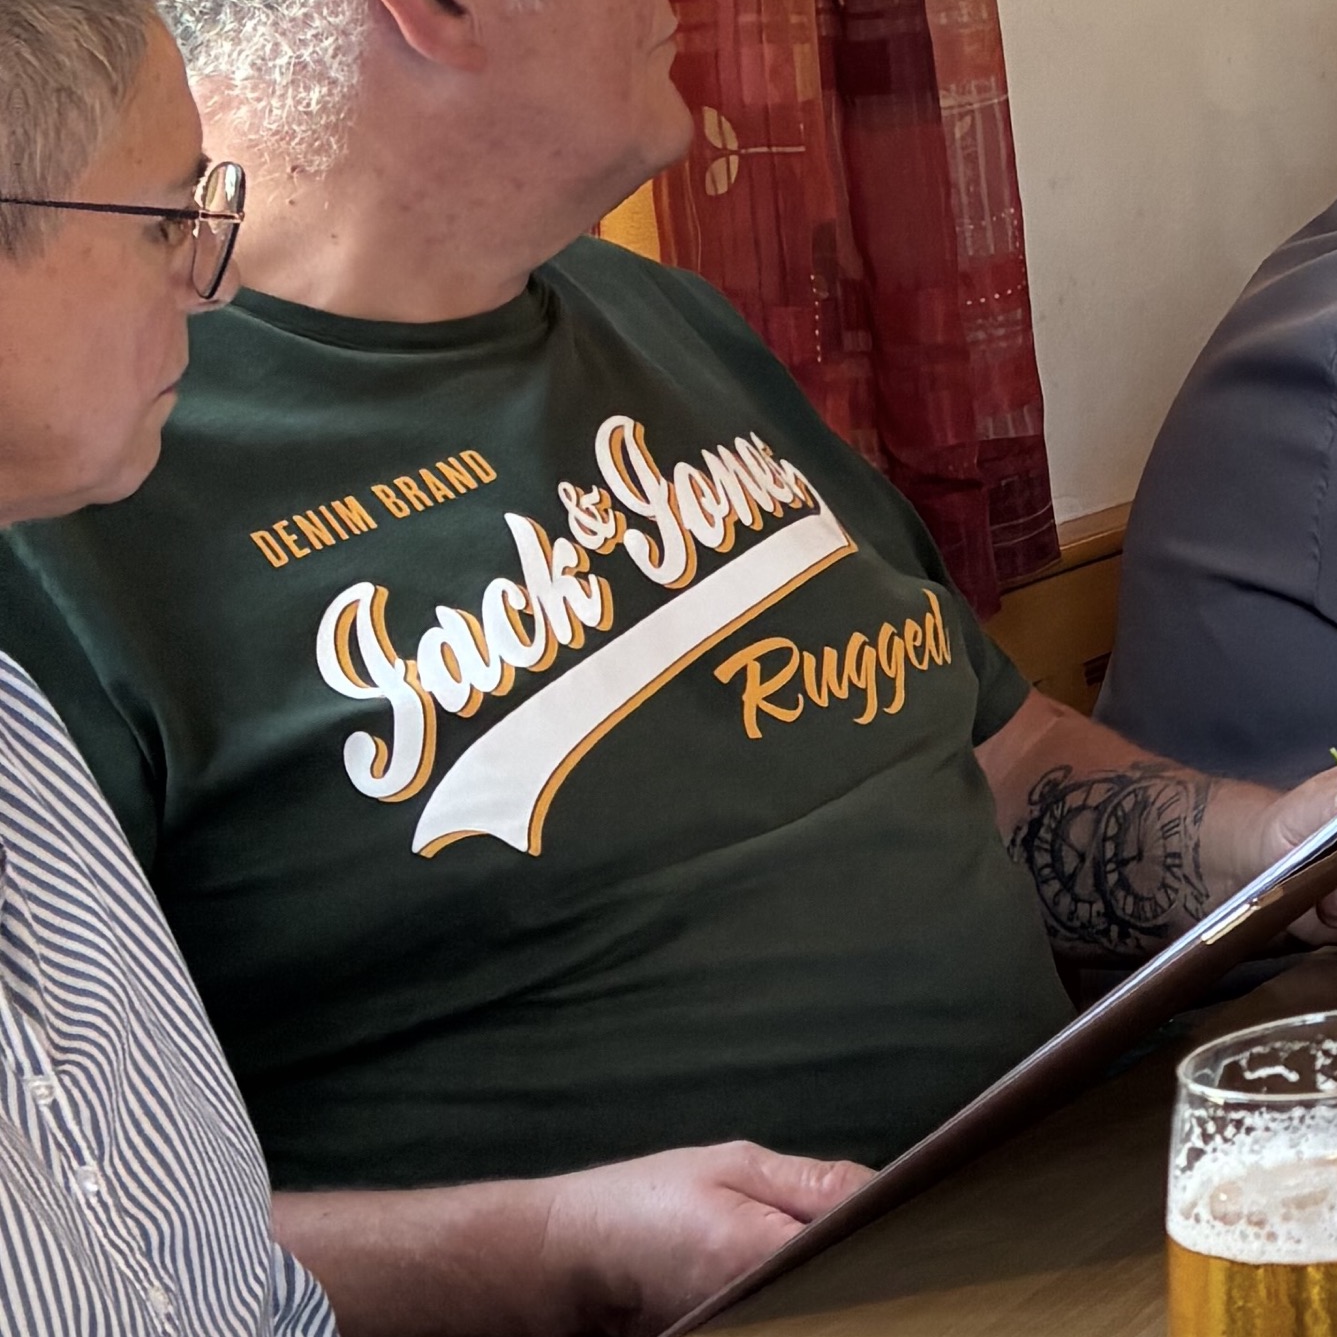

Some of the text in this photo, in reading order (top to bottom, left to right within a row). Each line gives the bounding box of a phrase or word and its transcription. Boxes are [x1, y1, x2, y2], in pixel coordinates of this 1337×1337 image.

[250, 450, 497, 568] DENIM BRAND
[315, 512, 614, 802] Jack
[557, 480, 626, 555] &
[713, 588, 952, 739] Rugged
